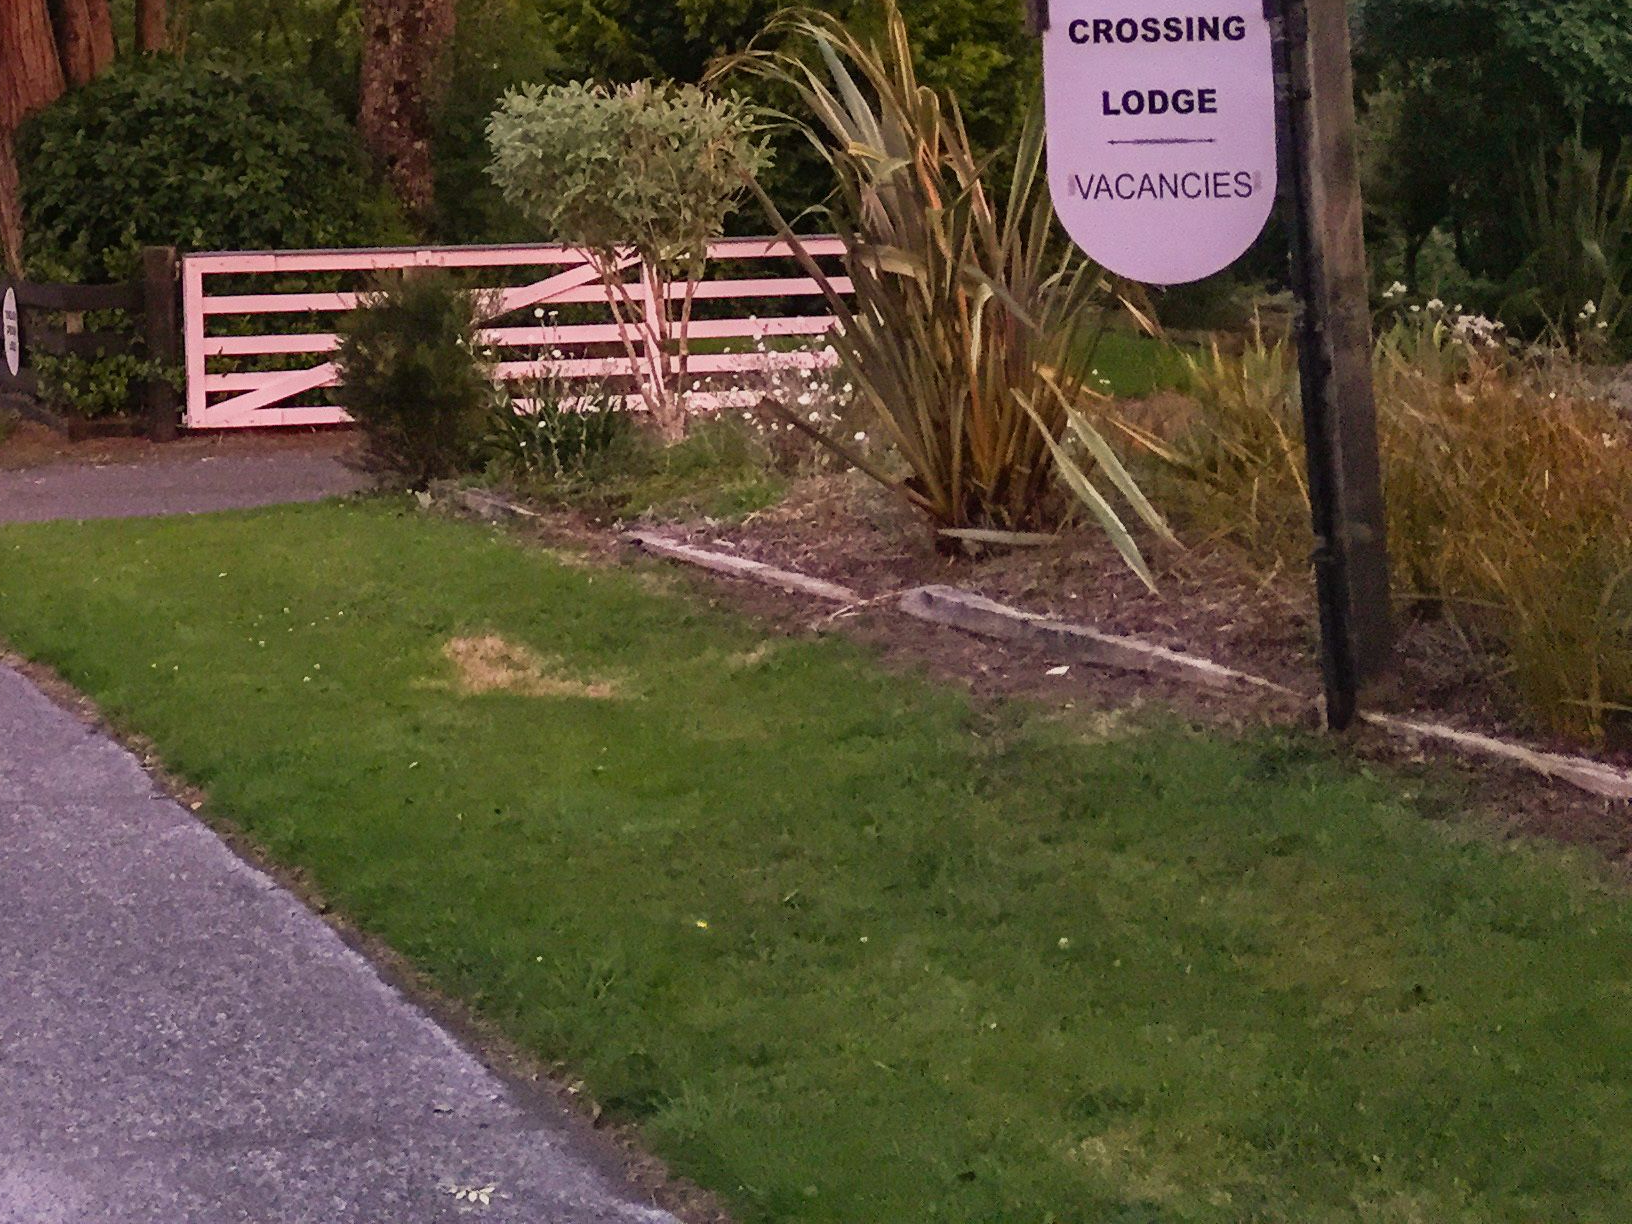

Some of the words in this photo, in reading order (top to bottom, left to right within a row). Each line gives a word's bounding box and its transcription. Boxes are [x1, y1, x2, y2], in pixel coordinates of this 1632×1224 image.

[1069, 15, 1246, 44] CROSSING
[1102, 89, 1218, 116] LODGE
[1075, 171, 1253, 201] VACANCIES
